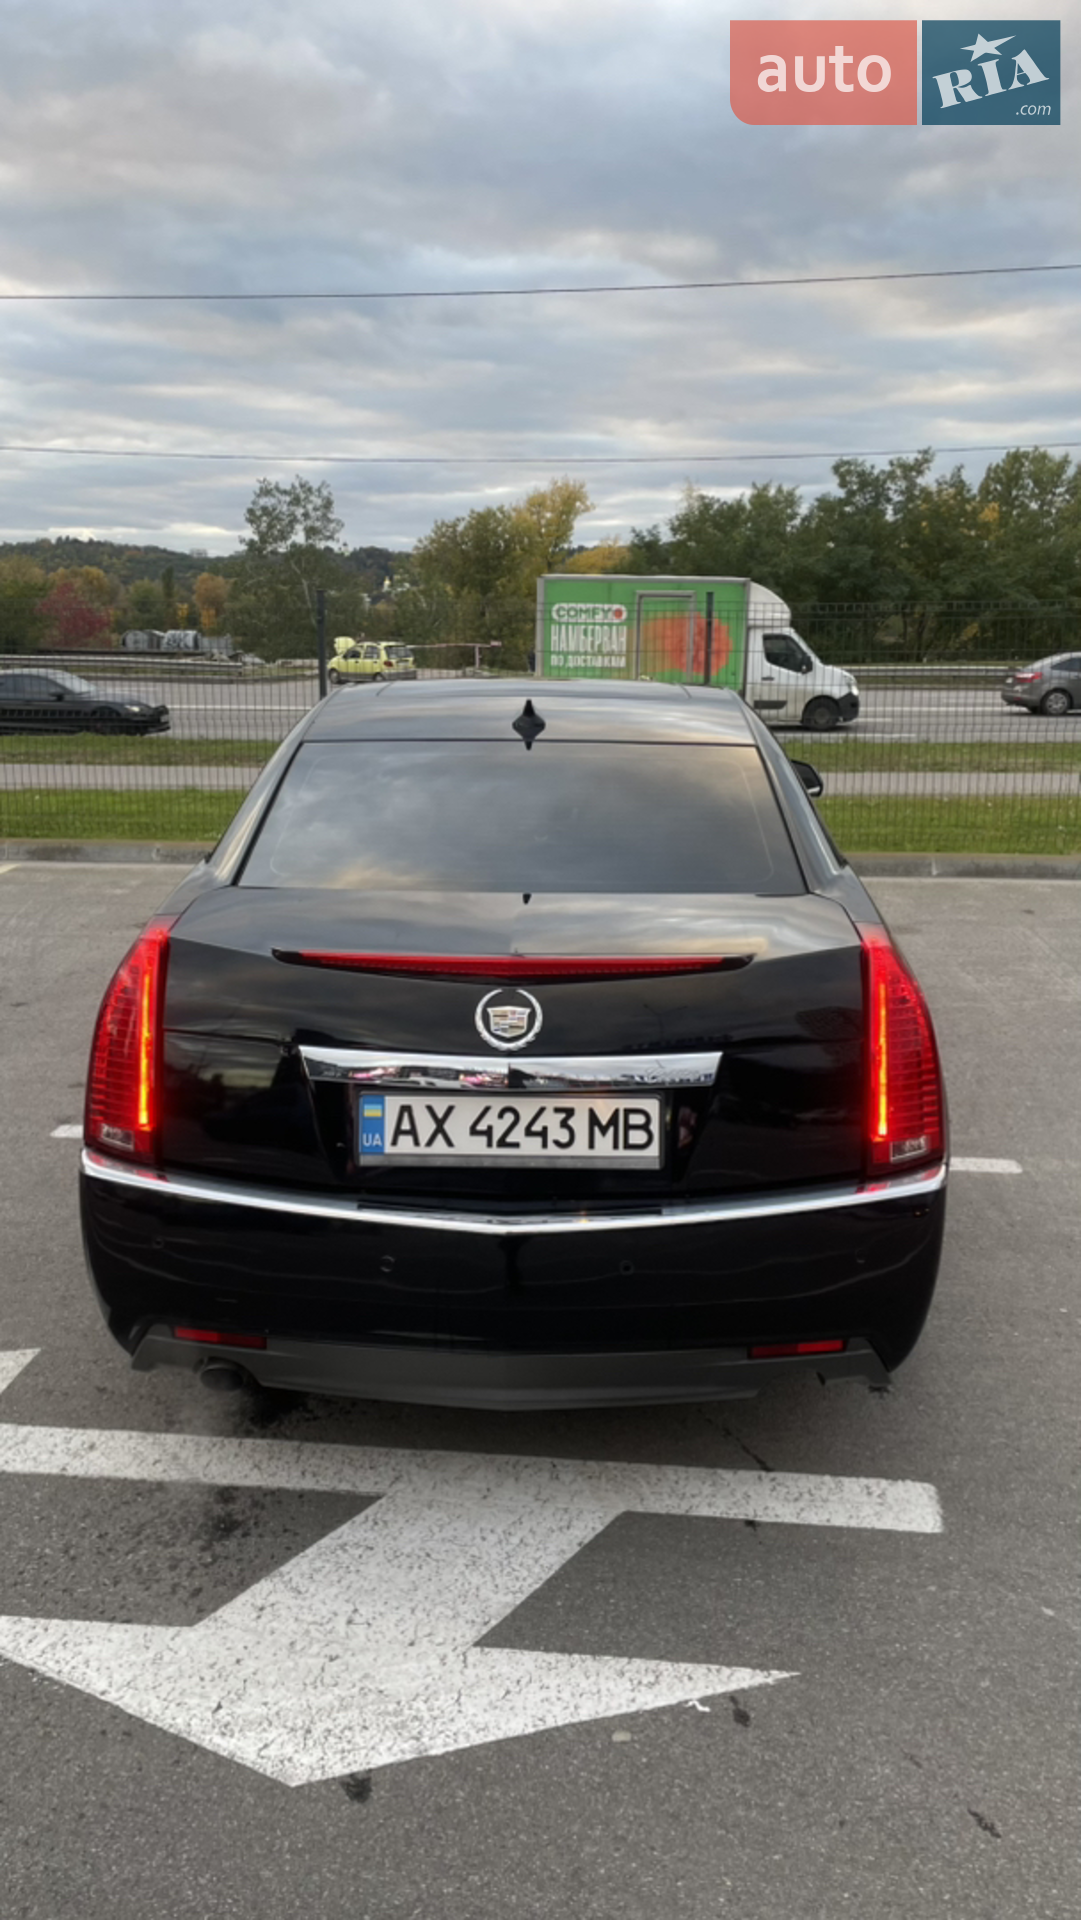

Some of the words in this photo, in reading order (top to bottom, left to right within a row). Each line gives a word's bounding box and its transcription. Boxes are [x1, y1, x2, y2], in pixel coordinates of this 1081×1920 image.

[556, 606, 612, 619] COMFY
[551, 625, 627, 654] НАМБЕРВАН
[391, 1104, 456, 1148] AX
[469, 1105, 575, 1149] 4243
[587, 1106, 655, 1151] MB
[362, 1133, 382, 1147] UA
